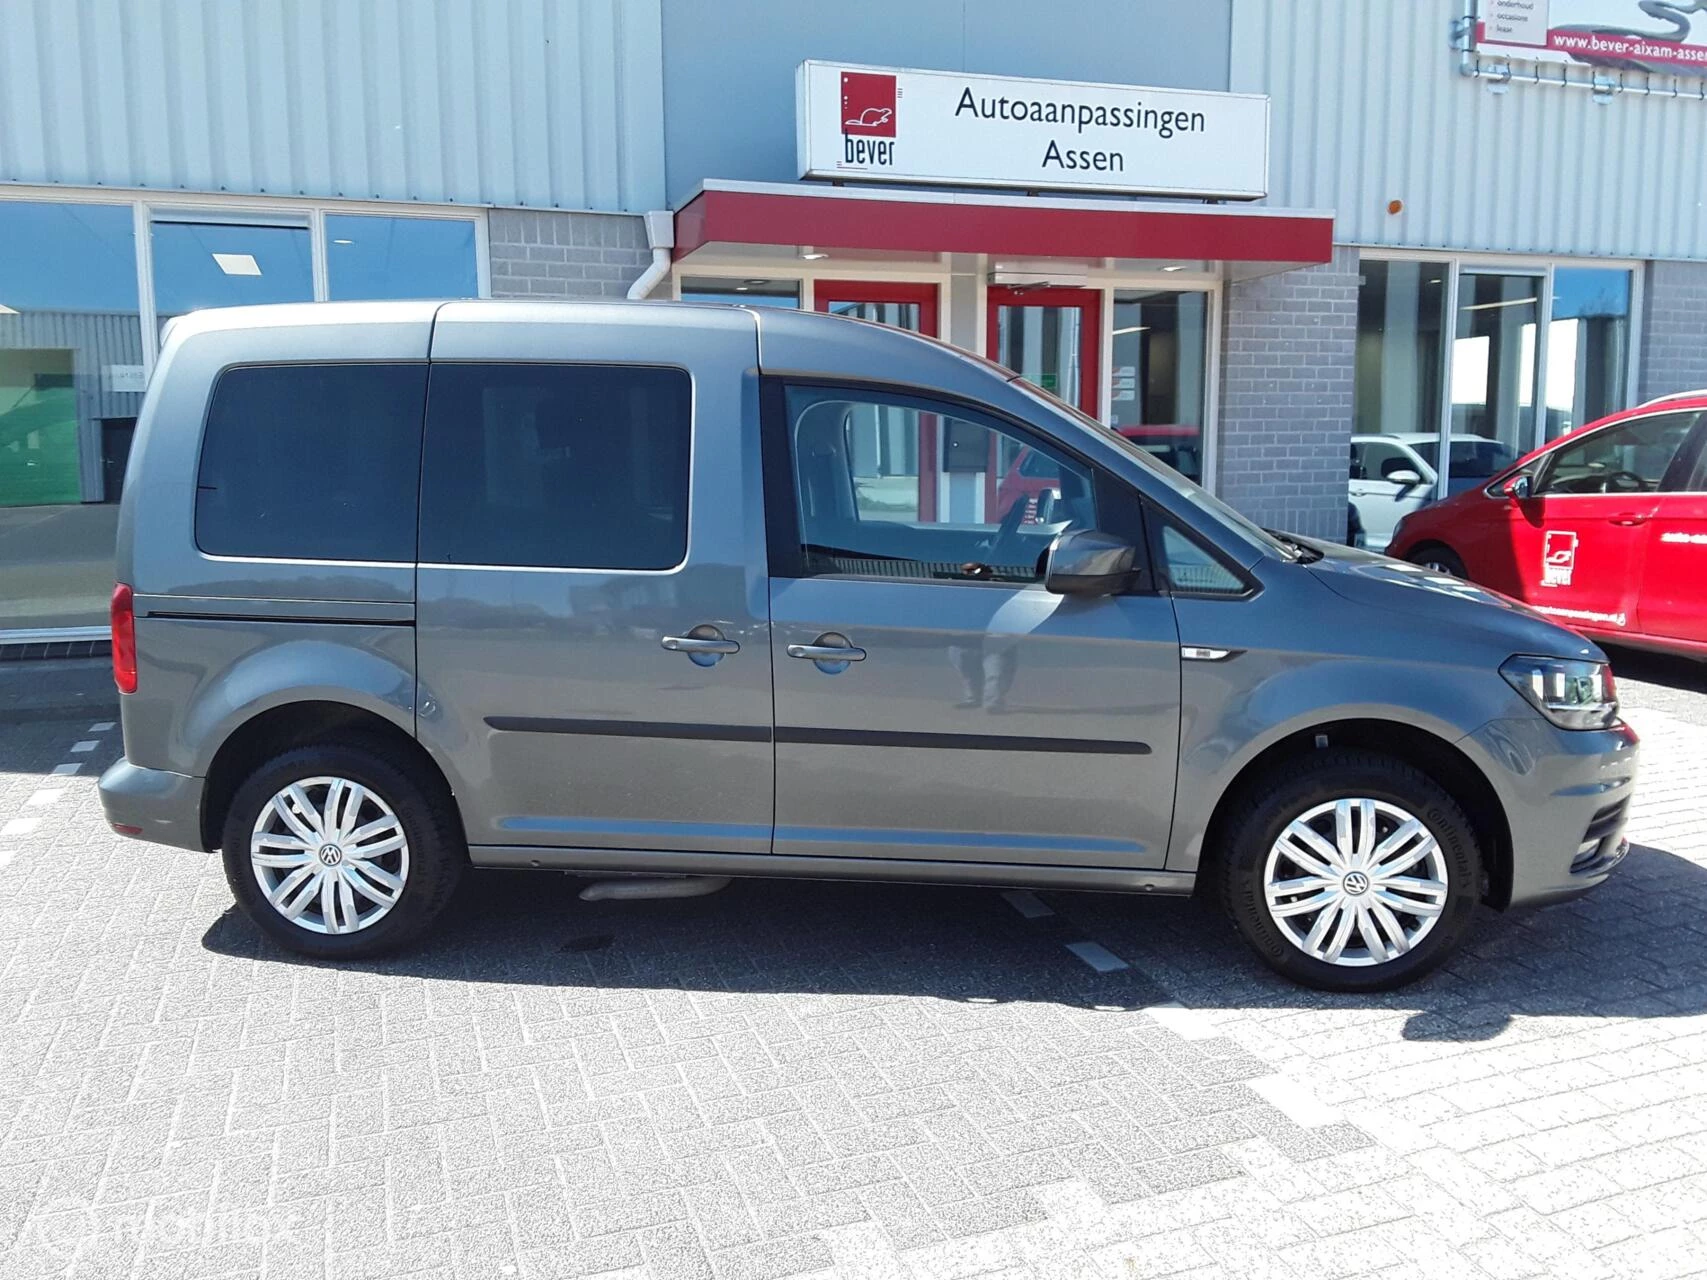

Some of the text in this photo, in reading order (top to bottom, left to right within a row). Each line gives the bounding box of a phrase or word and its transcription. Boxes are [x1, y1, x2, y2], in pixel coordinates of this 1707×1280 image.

[1553, 34, 1707, 62] www.bever-aixam-asse
[955, 87, 1206, 139] Autoaanpassingen
[844, 127, 896, 166] bever
[1041, 139, 1125, 172] Assen
